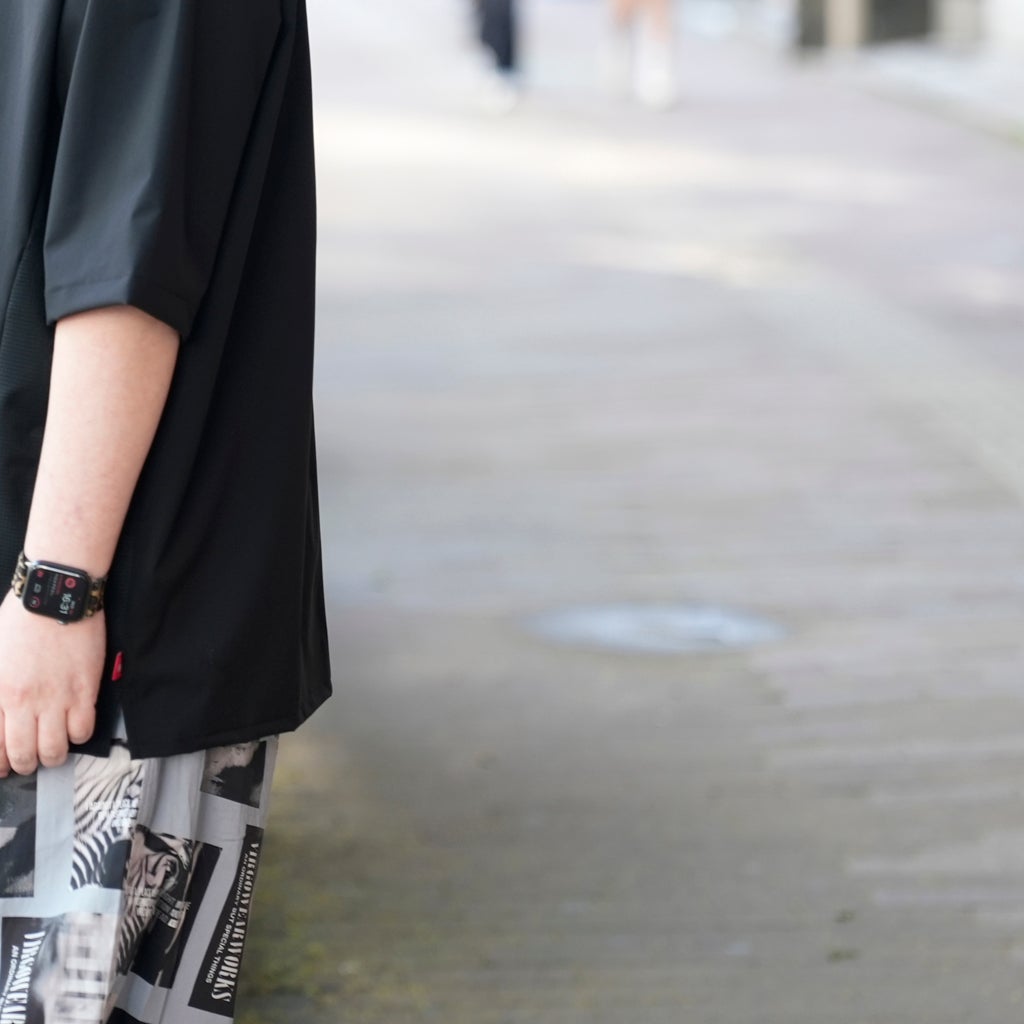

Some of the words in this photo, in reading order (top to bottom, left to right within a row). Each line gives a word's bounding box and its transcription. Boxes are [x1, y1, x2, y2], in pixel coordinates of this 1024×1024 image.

[242, 853, 249, 866] AN
[232, 866, 247, 907] ORDINARY
[211, 843, 259, 1002] VIRGOWEARWORKS
[229, 907, 238, 924] BUT
[216, 923, 233, 958] SPECIAL
[205, 956, 219, 984] THINGS
